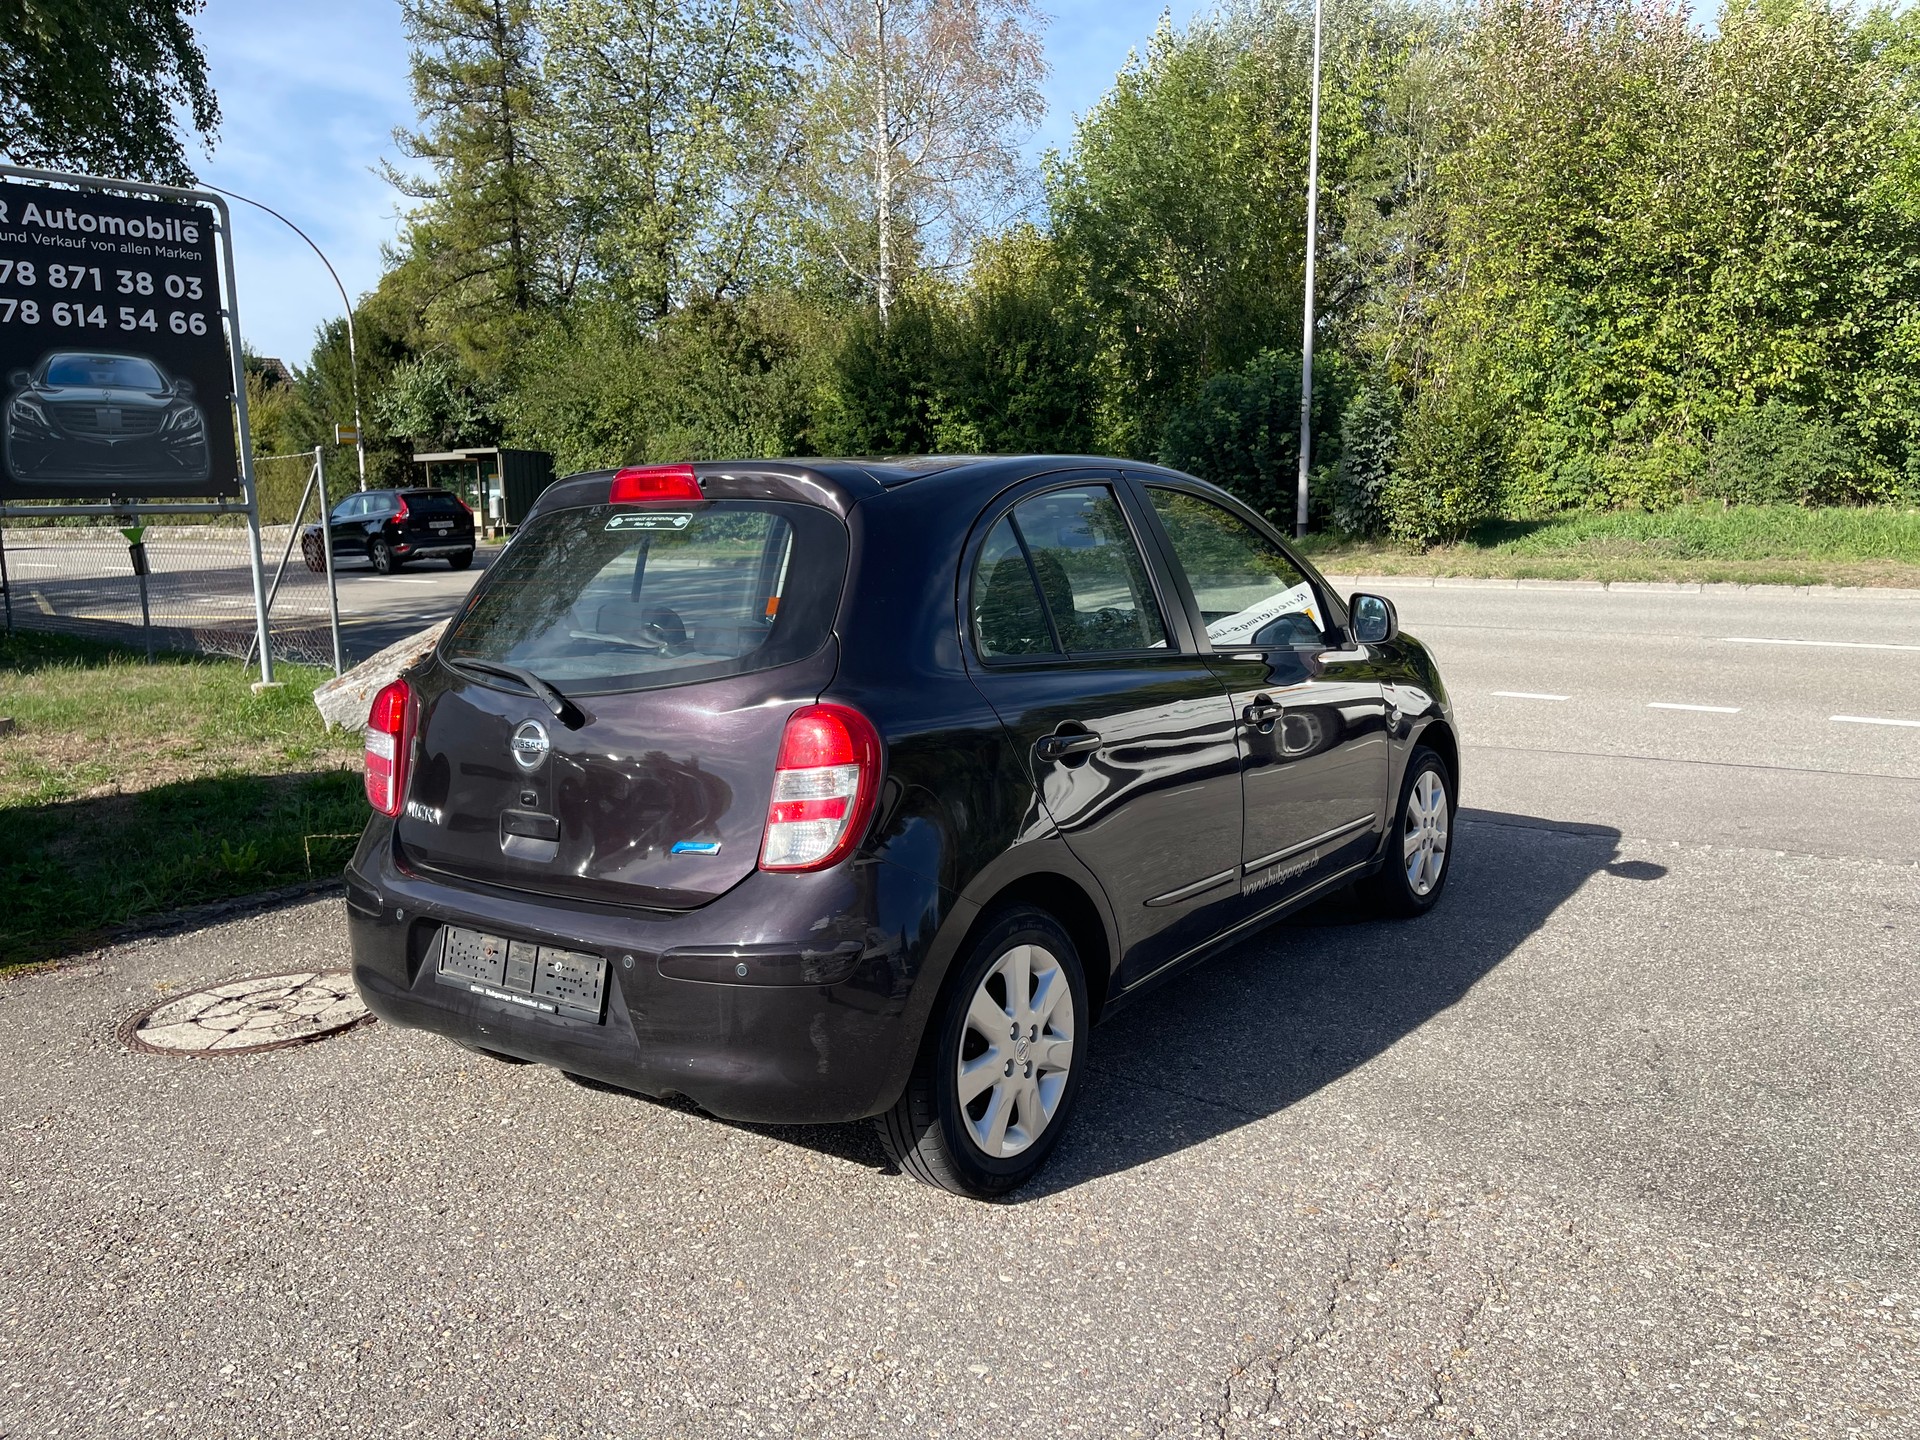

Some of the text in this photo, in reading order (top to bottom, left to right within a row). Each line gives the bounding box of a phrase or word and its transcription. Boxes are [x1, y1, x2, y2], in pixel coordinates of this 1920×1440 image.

[21, 202, 200, 244] Automobile
[0, 231, 202, 261] und Verkauf von allen Marken
[0, 260, 203, 300] 78 871 38 03
[0, 298, 208, 336] 78 614 54 66
[512, 740, 544, 749] NISSAN
[406, 800, 442, 825] MICRA
[1243, 849, 1320, 897] www.hubgarage.ch
